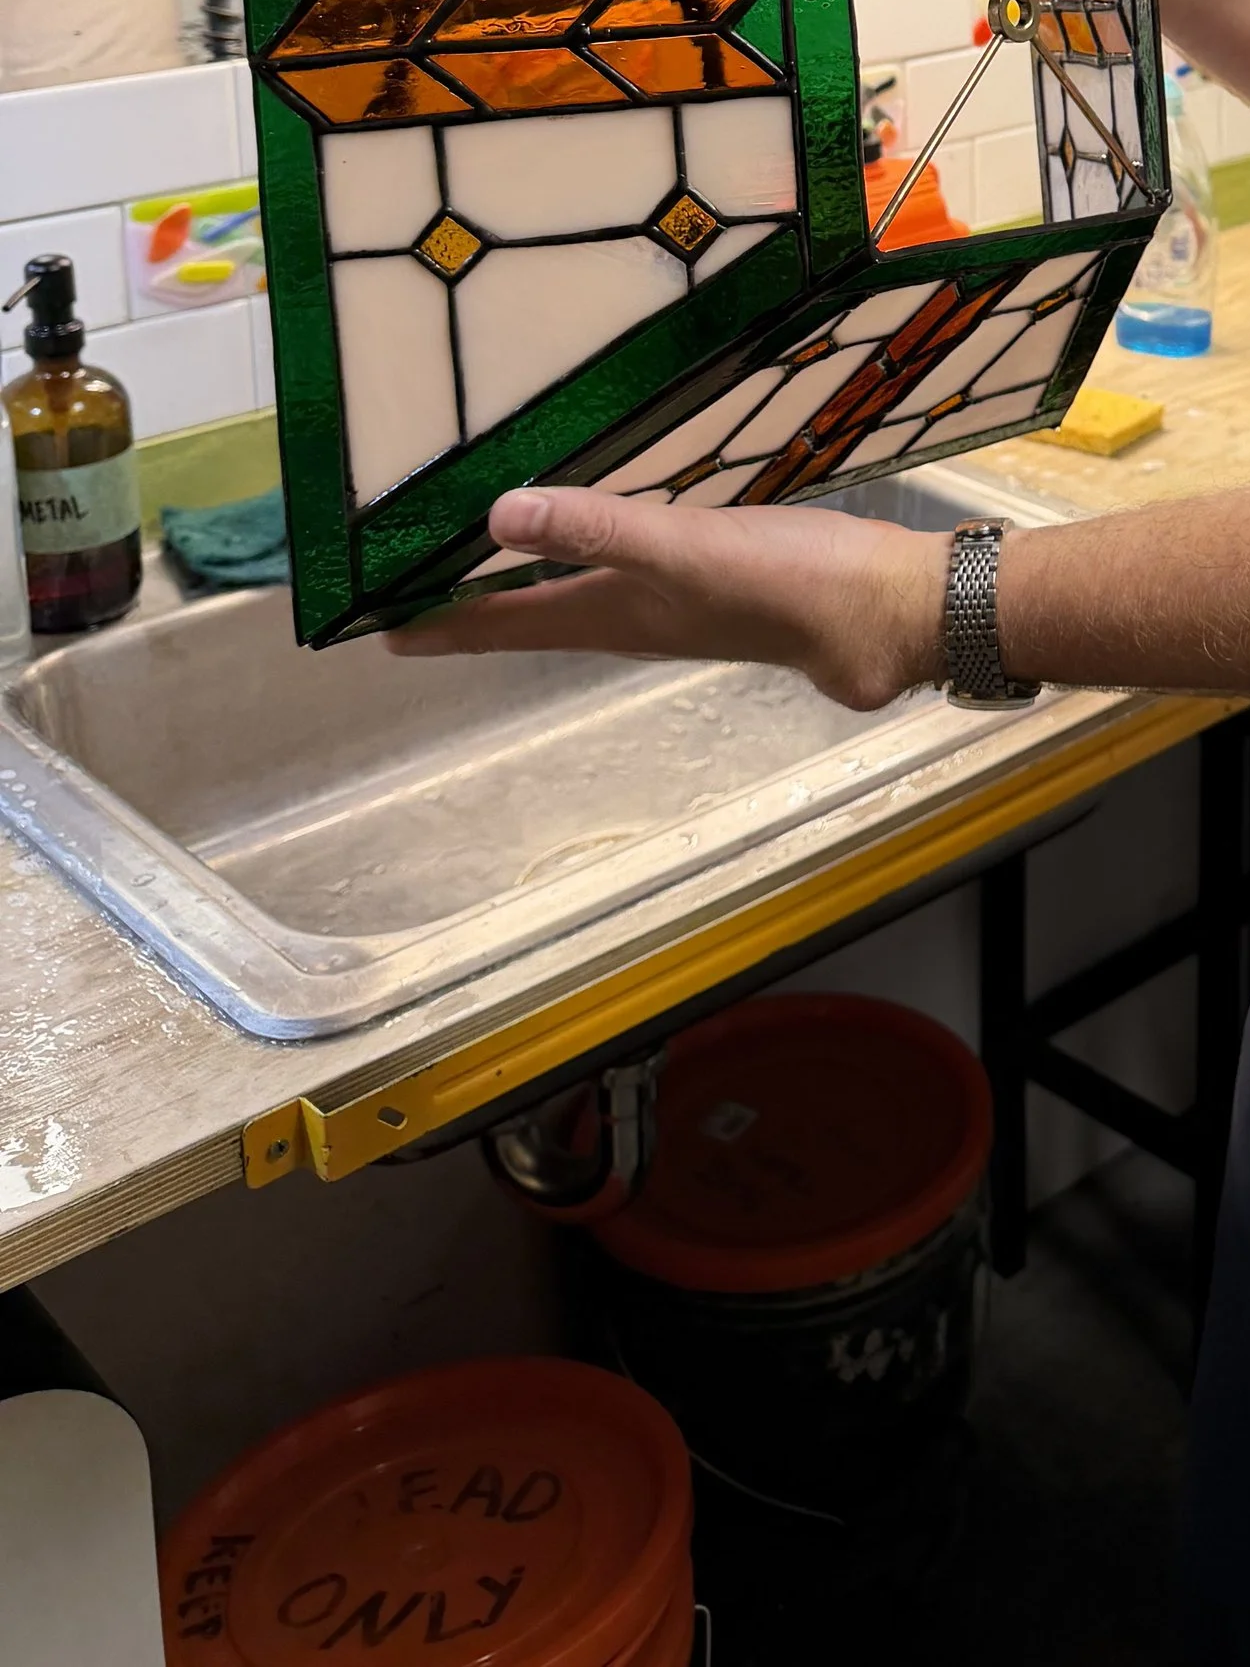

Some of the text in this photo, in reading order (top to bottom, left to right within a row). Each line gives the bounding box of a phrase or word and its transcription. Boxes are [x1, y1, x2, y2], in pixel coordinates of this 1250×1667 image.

[18, 495, 90, 524] METAL
[352, 1465, 562, 1523] EAD
[276, 1566, 526, 1650] ONLY
